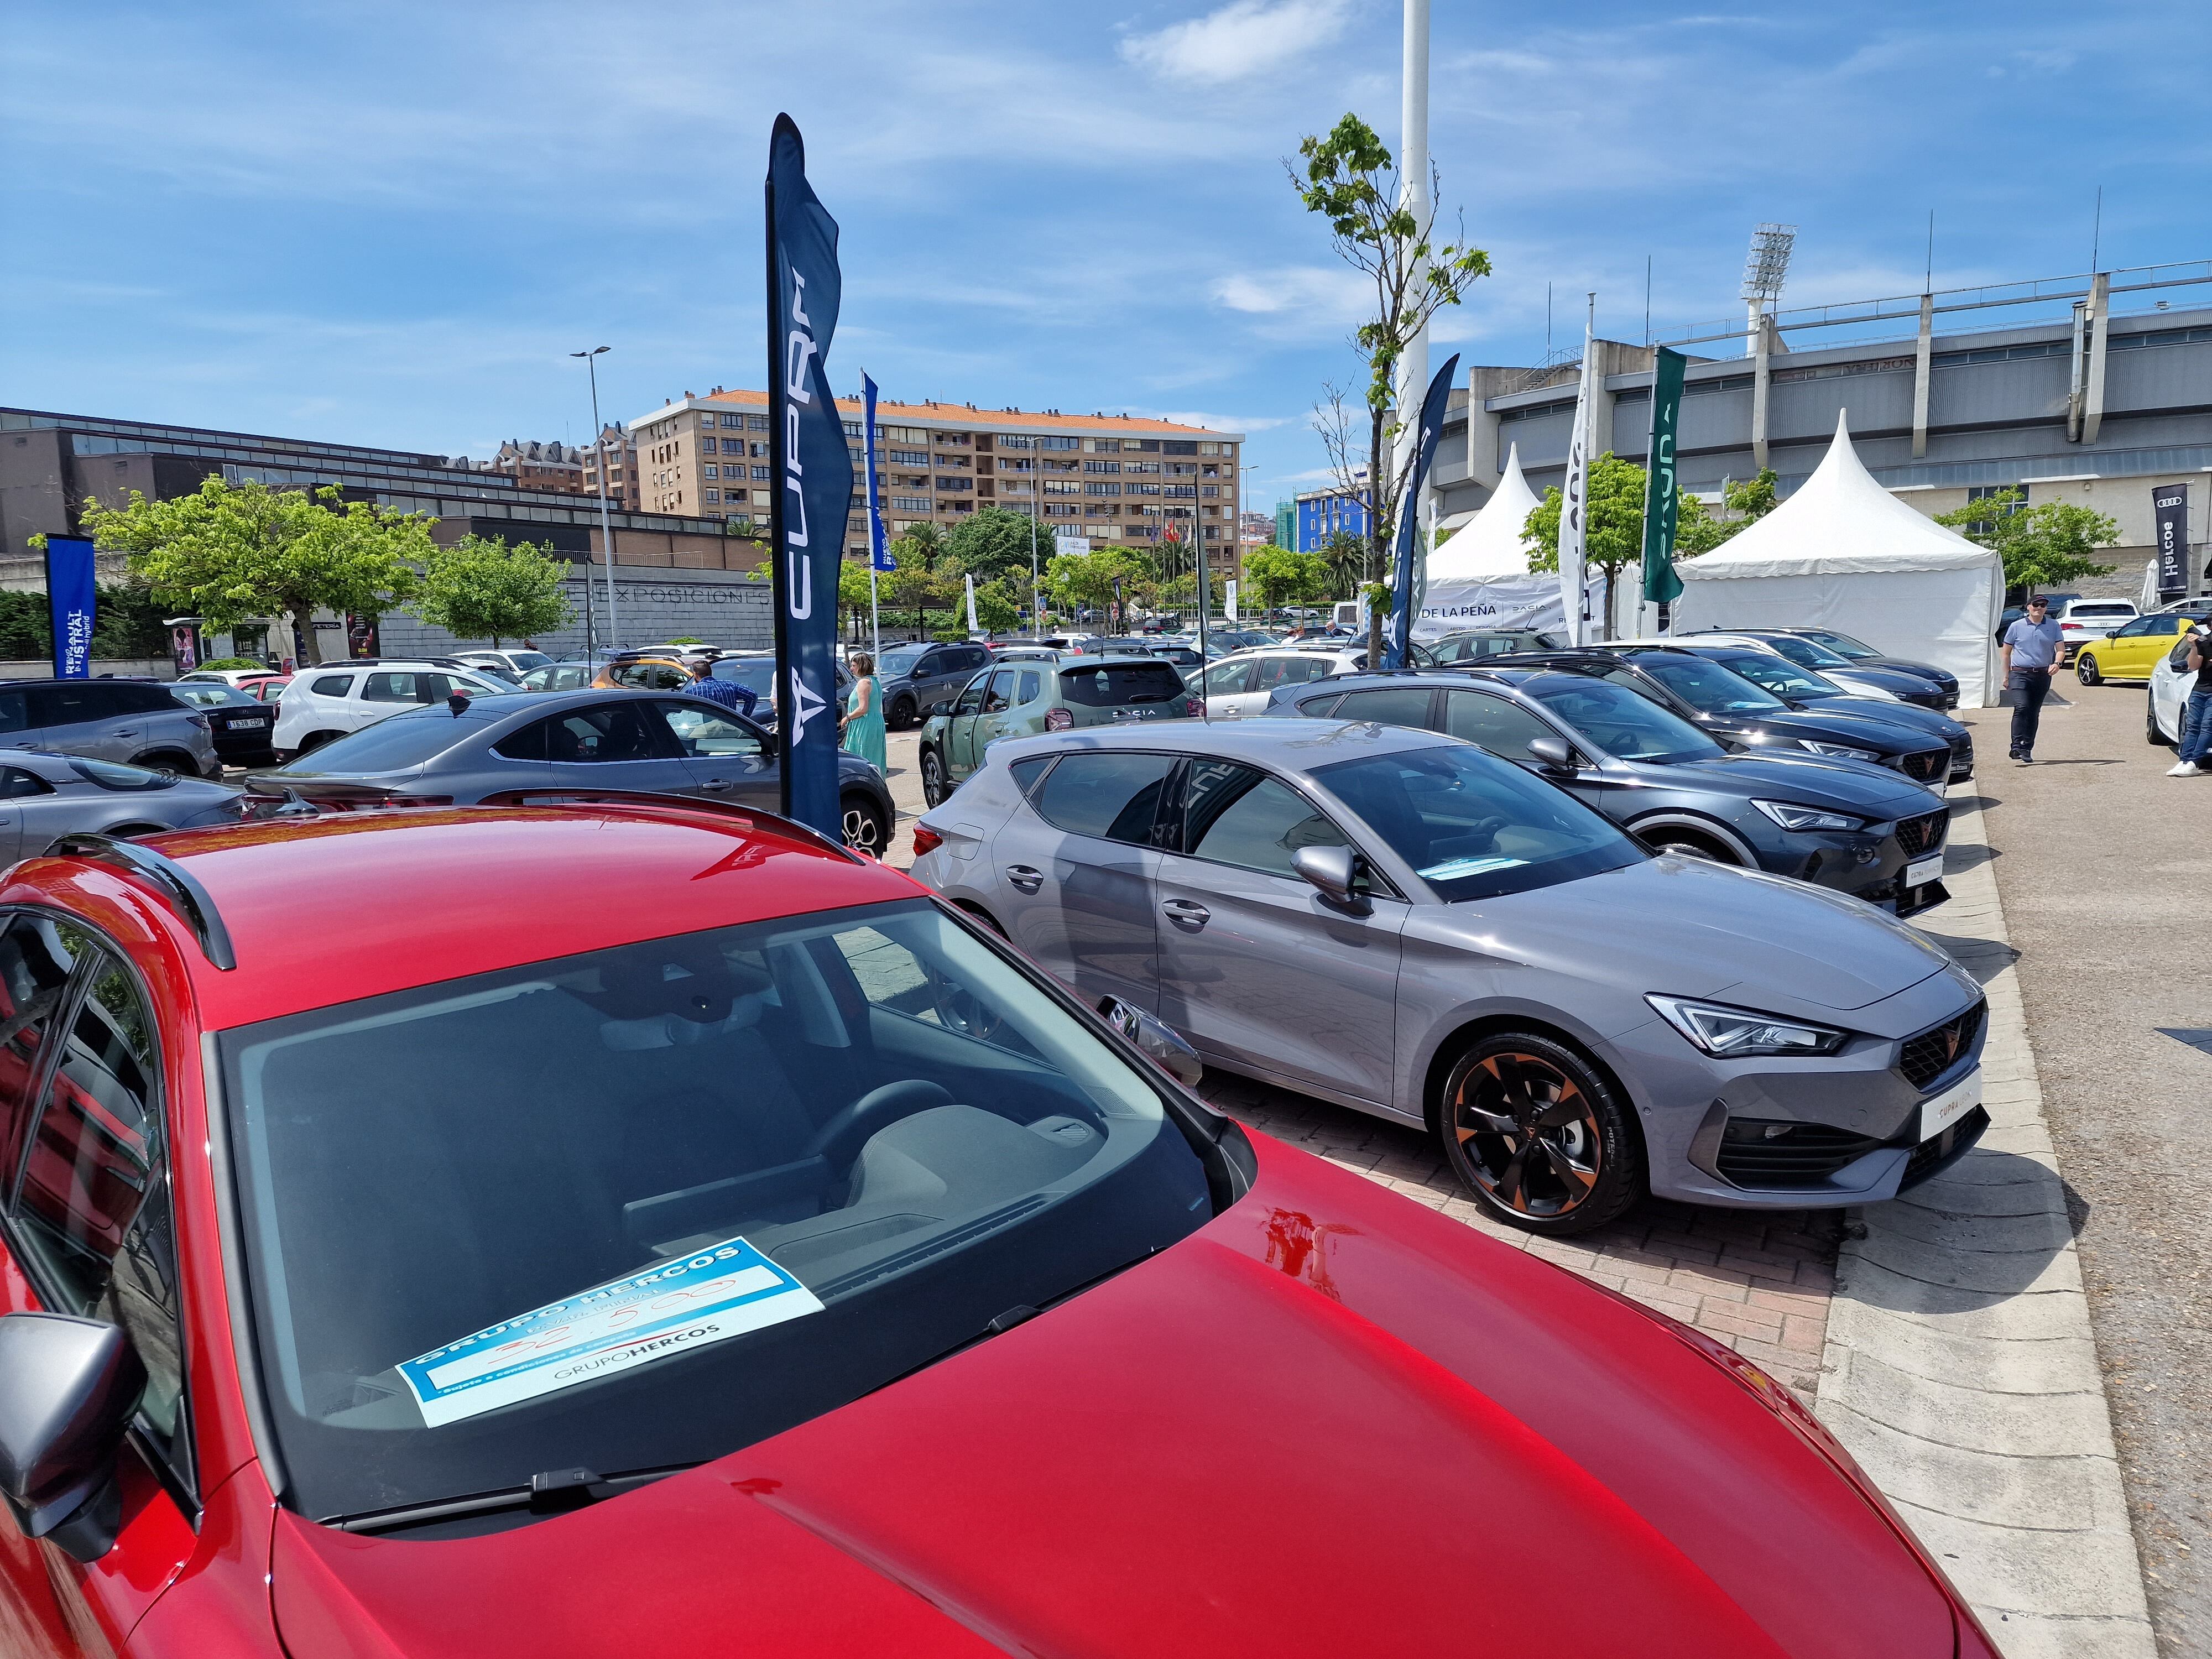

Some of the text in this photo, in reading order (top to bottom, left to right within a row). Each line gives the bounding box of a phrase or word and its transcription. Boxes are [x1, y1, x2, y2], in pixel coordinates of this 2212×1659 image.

[787, 265, 817, 620] CUPRA
[1422, 604, 1496, 618] DE LA PEÑA
[82, 615, 92, 638] hybrid
[1939, 1101, 1958, 1119] CUPRA
[415, 1246, 742, 1365] GRUPO HERCOS
[495, 1352, 567, 1378] condiciones
[569, 1347, 583, 1355] de
